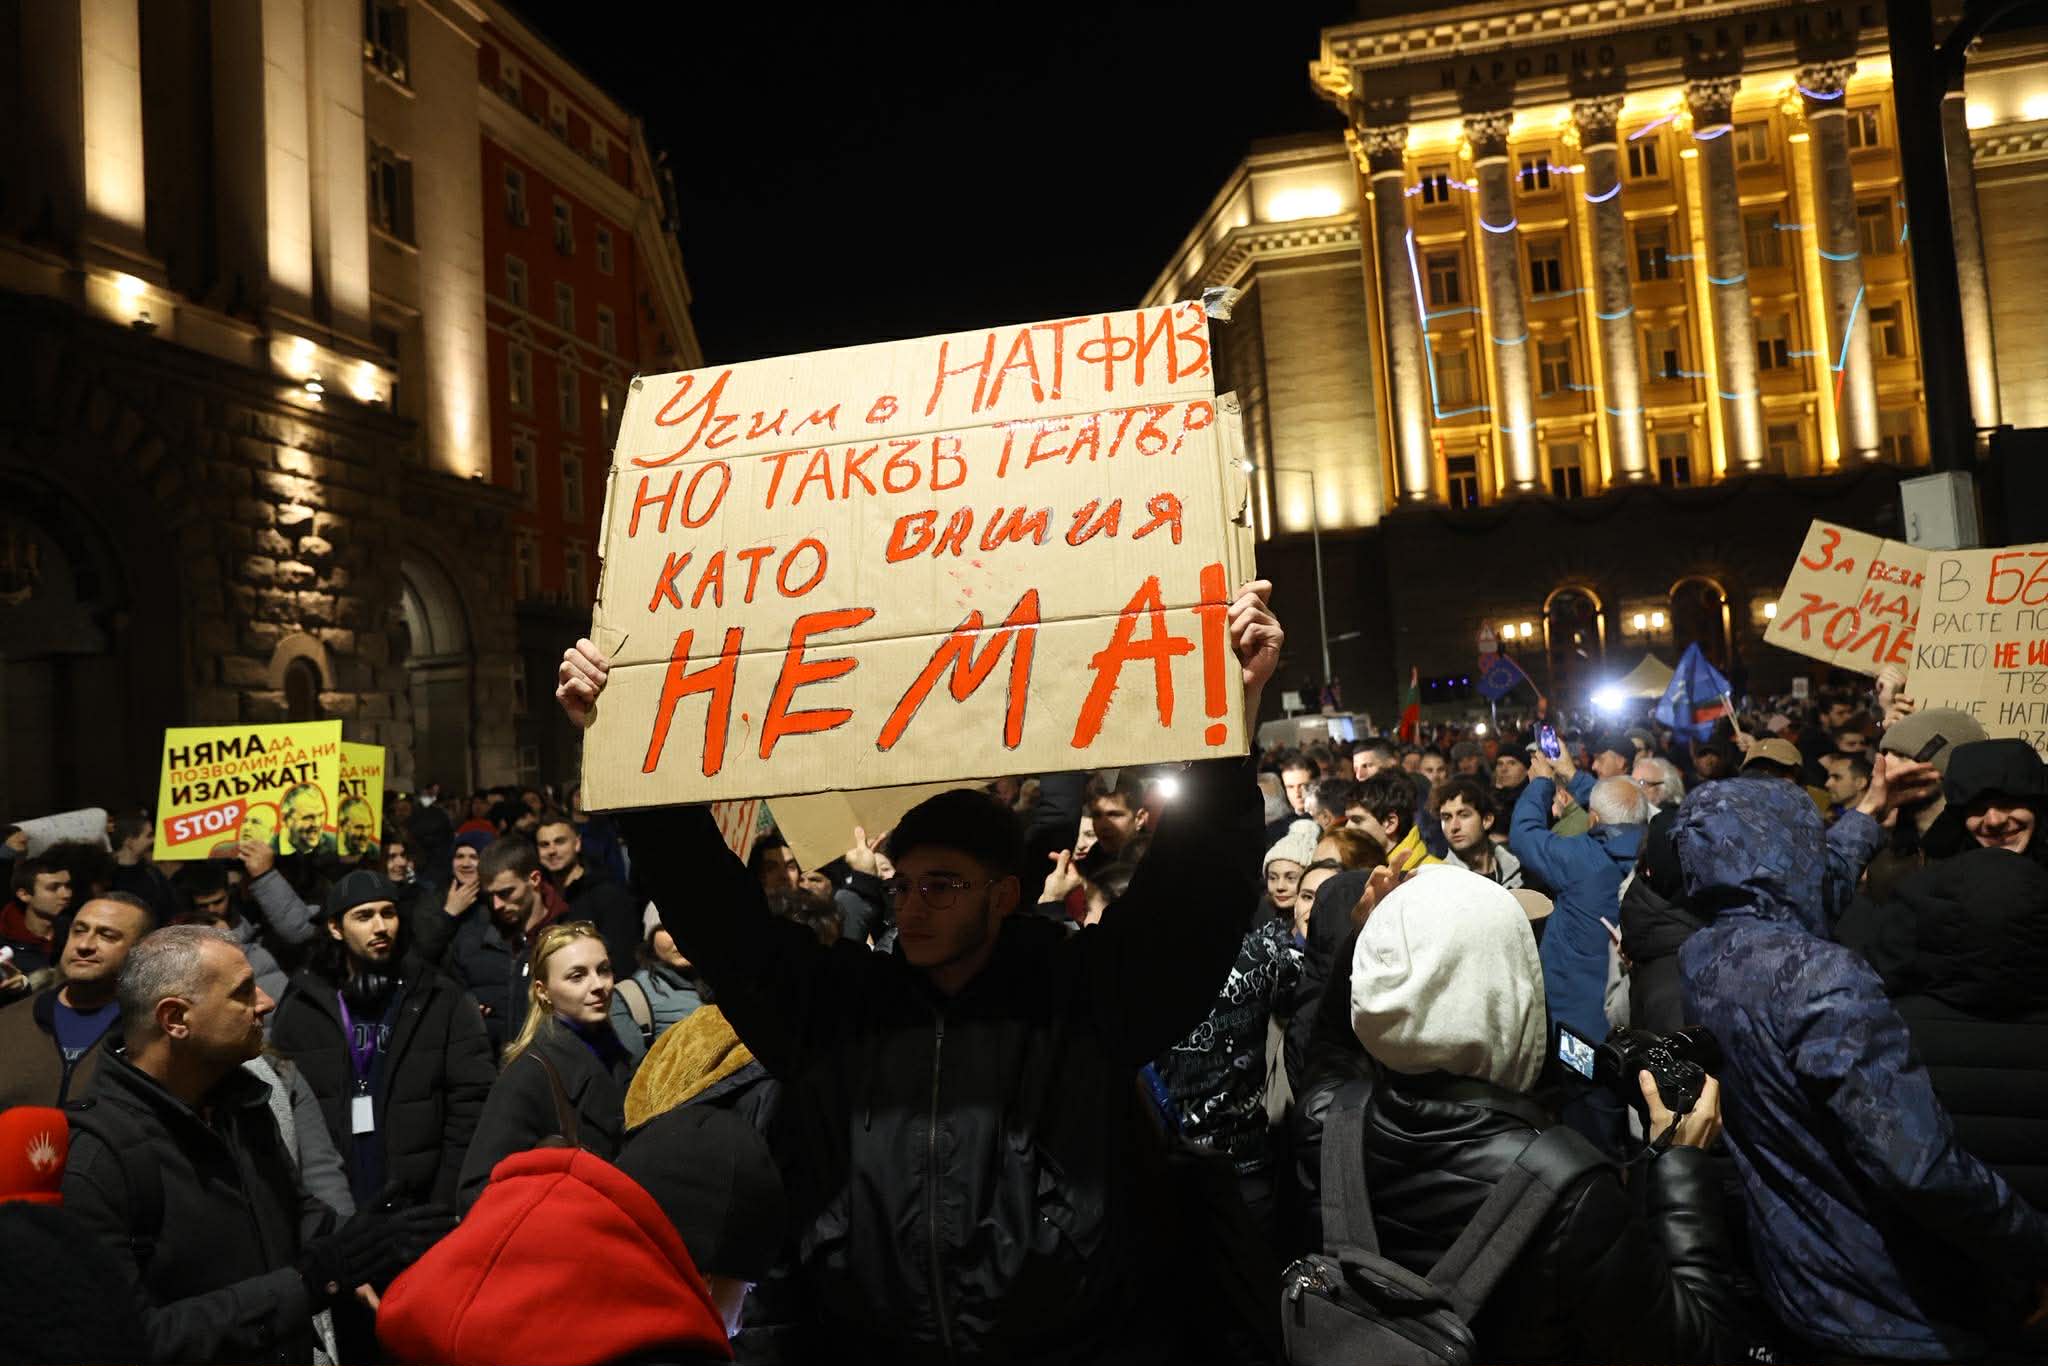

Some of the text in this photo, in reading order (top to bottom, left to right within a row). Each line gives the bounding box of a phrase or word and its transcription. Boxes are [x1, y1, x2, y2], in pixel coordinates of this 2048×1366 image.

[631, 369, 841, 468] Учим
[628, 400, 1215, 538] НО ТАКЪВ ТЕАТЪР
[648, 536, 828, 613] КАТО
[1938, 559, 1971, 602] В
[1932, 611, 2003, 635] РАСТЕ
[641, 561, 1230, 778] НЕМА!
[1916, 643, 1988, 670] КОЕТО
[1993, 641, 2022, 669] НЕ
[1998, 701, 2048, 726] НАП
[168, 734, 294, 769] НЯМА ДА
[170, 742, 337, 785] ПОЗВОЛИМ ДА НИ
[171, 761, 319, 806] ИЗЛЪЖАТ!
[174, 804, 240, 841] STOP
